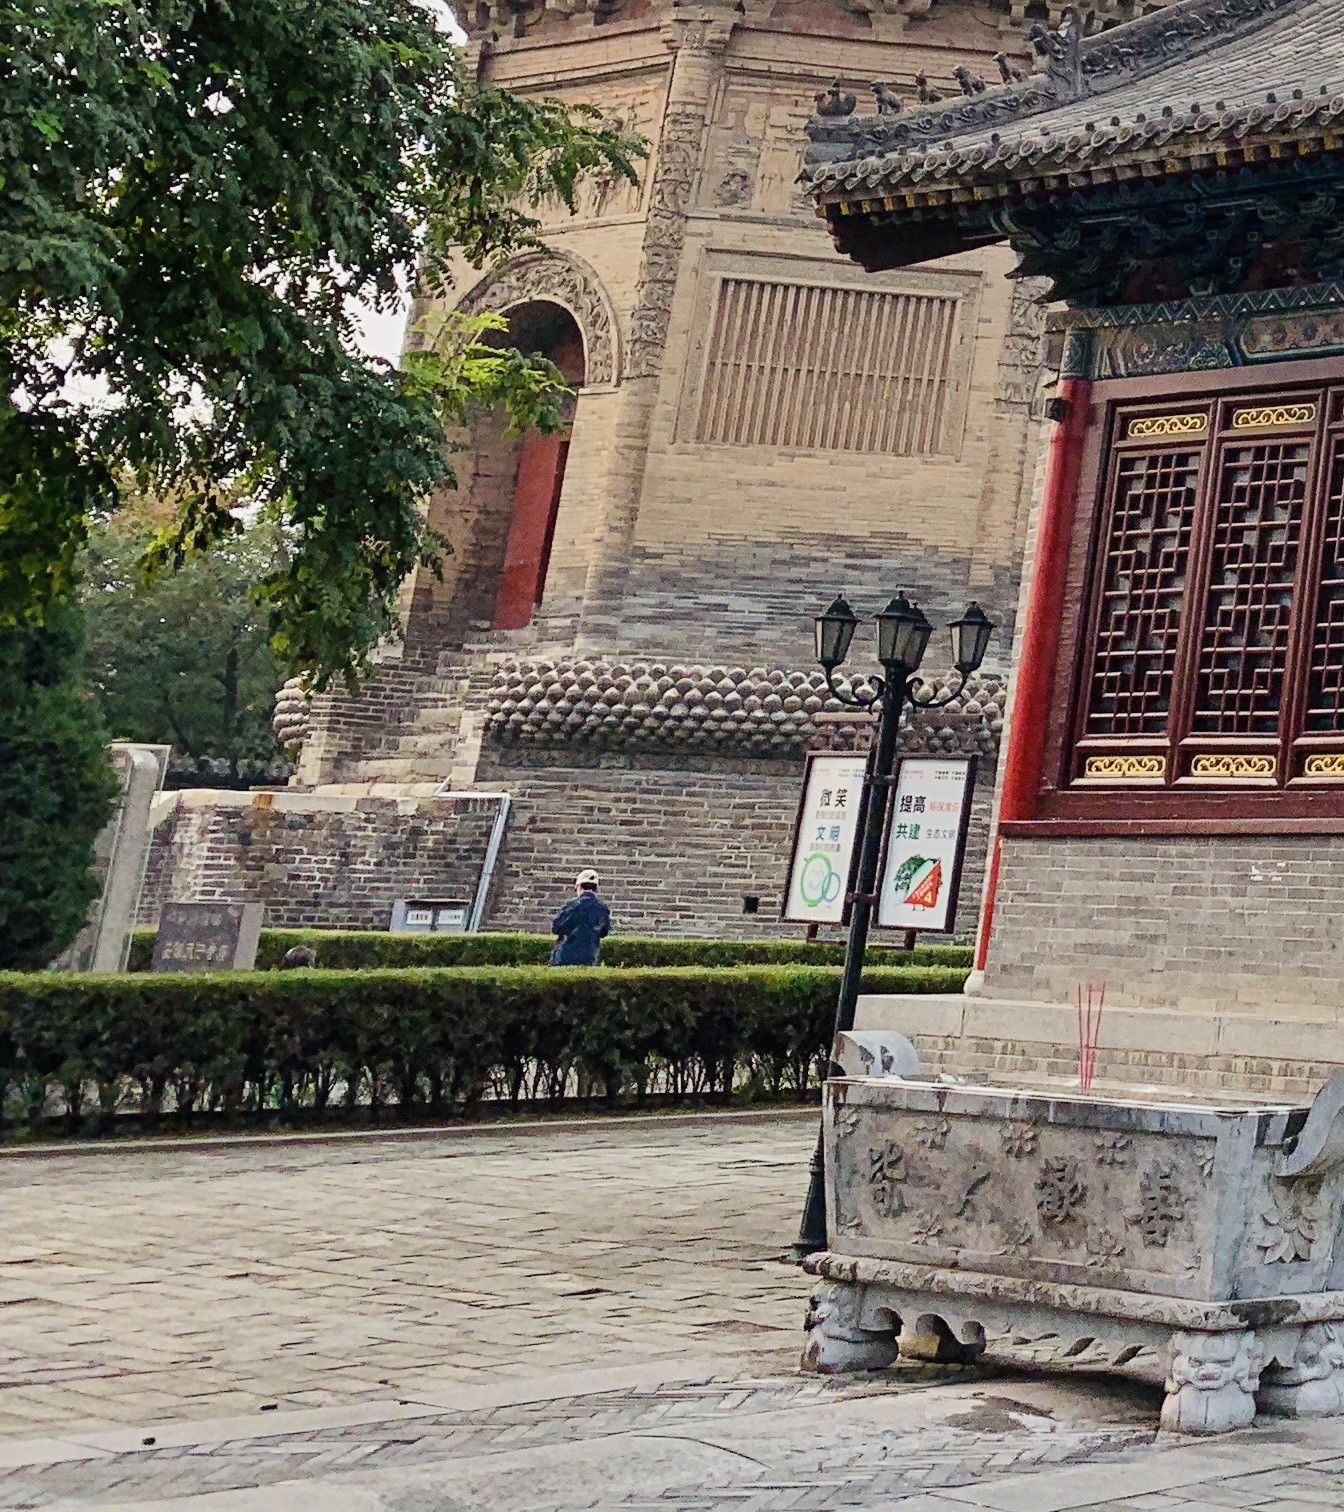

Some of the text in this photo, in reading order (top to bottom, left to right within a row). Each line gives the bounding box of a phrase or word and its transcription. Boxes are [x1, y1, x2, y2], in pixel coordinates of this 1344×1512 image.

[820, 788, 848, 808] 微笑
[899, 795, 927, 813] 提高
[895, 822, 921, 840] 共建
